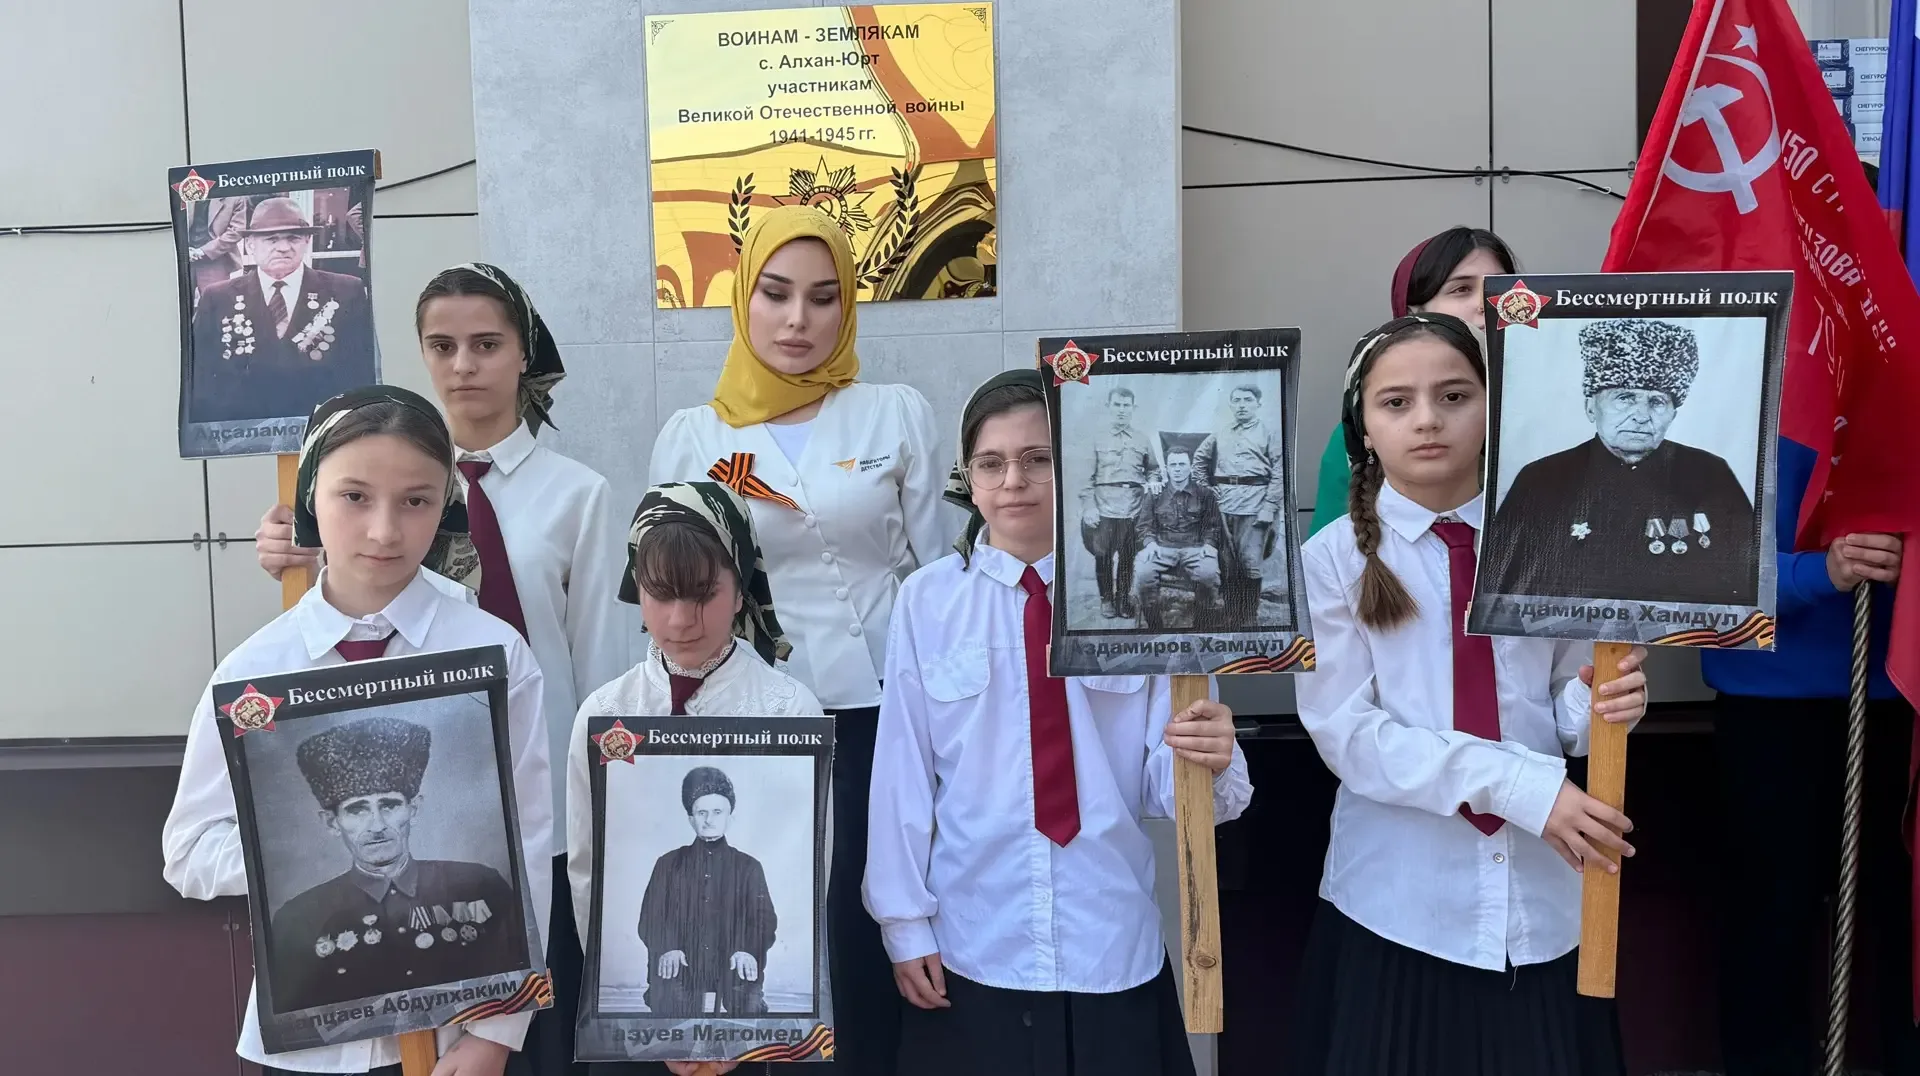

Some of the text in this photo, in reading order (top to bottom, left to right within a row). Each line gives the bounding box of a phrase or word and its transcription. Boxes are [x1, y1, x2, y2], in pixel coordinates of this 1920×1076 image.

[717, 27, 799, 48] ВОИНАМ
[815, 24, 920, 43] ЗЕМЛЯКАМ
[758, 52, 880, 71] с. Алхан-Юрт
[767, 78, 873, 98] участникам
[678, 98, 965, 124] Великой Отечественной войны
[768, 127, 876, 144] 1941-1945 гг.
[1782, 129, 1819, 180] 150
[217, 163, 366, 189] Бессмертный полк
[1555, 288, 1778, 310] Бессмертный полк
[1102, 343, 1289, 367] Бессмертный полк
[860, 463, 883, 472] ДЕТСТВА
[1489, 598, 1739, 628] Аздамиров Хамдул
[1071, 636, 1285, 658] Аздамиров Хамдул
[287, 663, 495, 707] Бессмертный полк
[648, 728, 823, 749] Бессмертный полк
[381, 979, 518, 1015] Абдулхаким
[693, 1024, 803, 1045] Магомед
